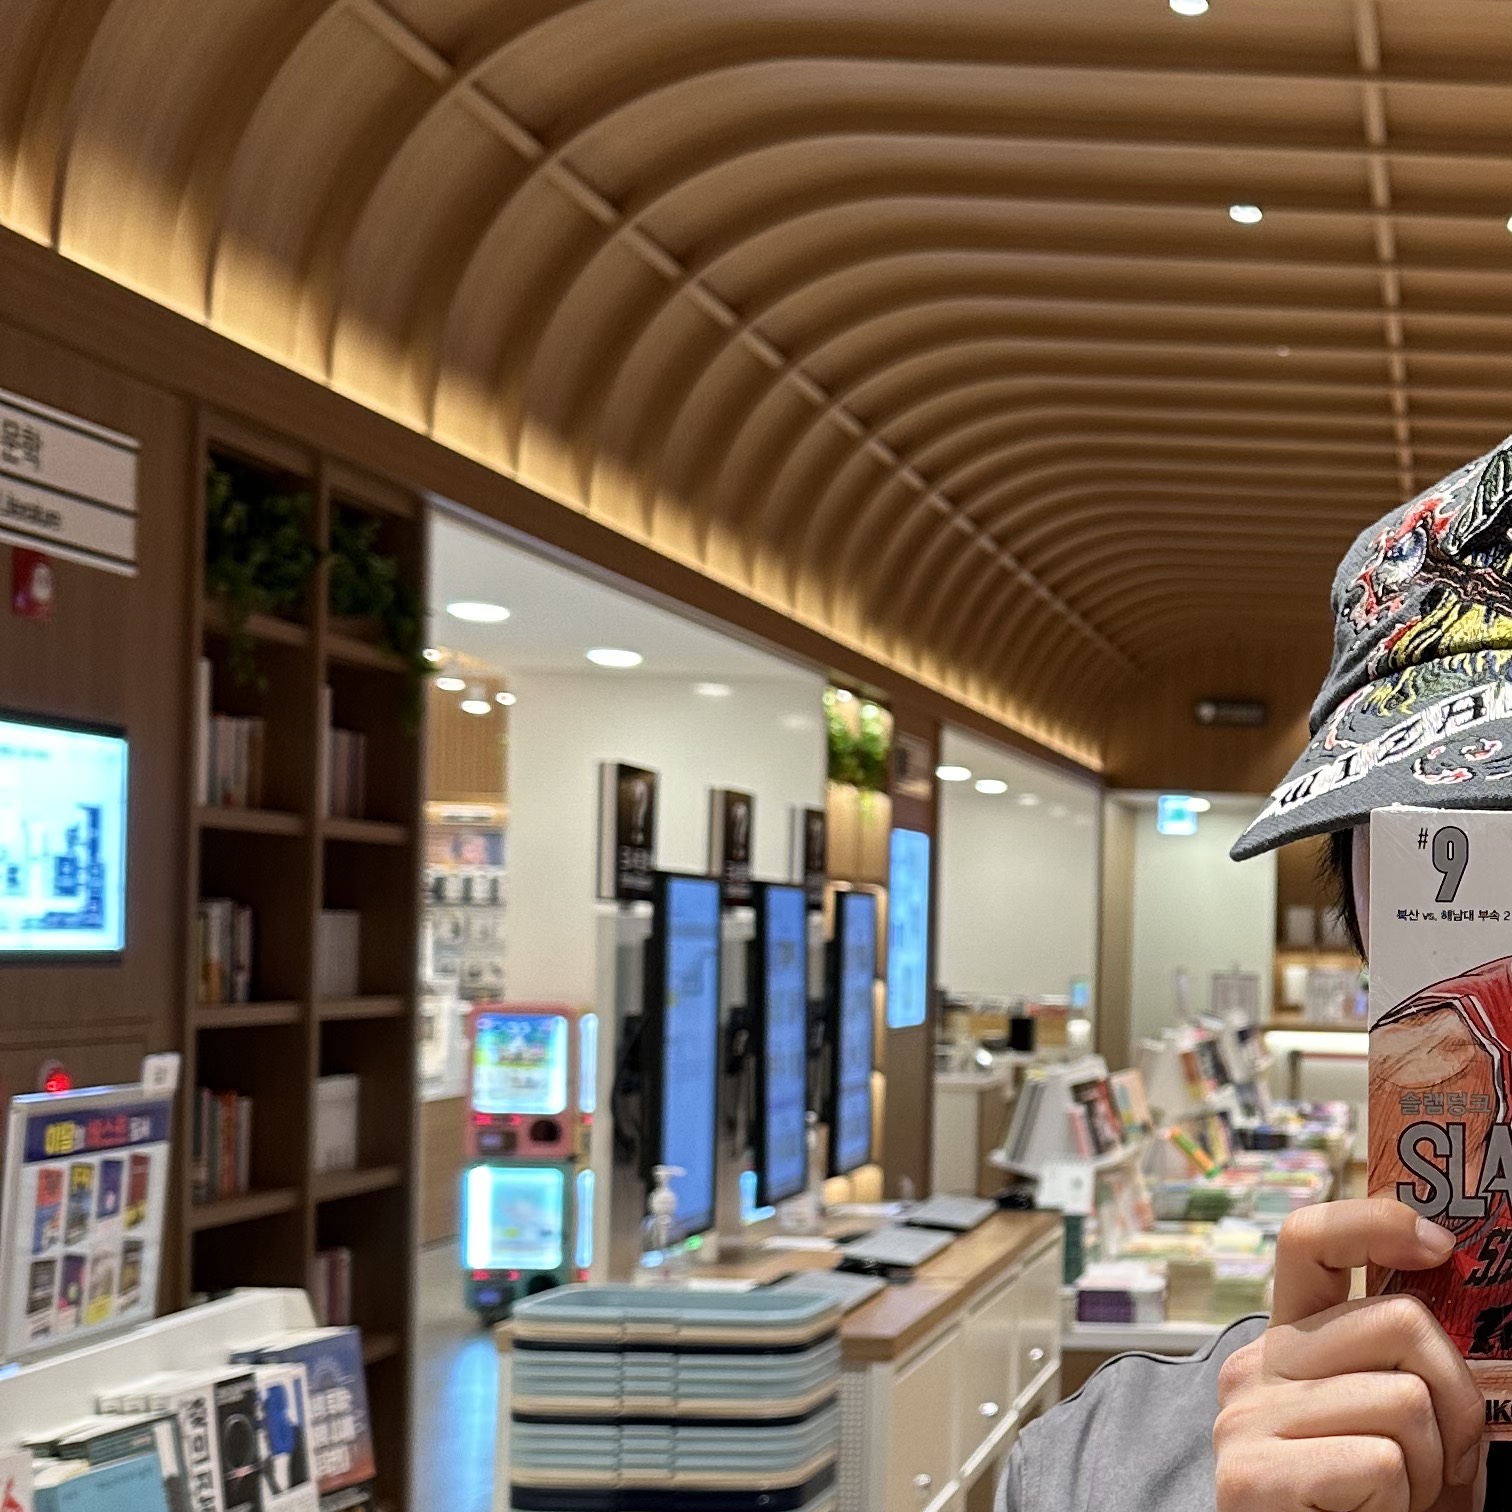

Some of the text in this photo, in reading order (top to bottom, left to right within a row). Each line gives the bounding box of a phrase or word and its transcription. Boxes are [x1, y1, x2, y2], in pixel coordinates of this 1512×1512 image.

[1440, 909, 1475, 922] 해남대
[1478, 909, 1501, 922] 부속
[1503, 910, 1512, 921] 2
[1399, 1091, 1492, 1116] 슬램덩크
